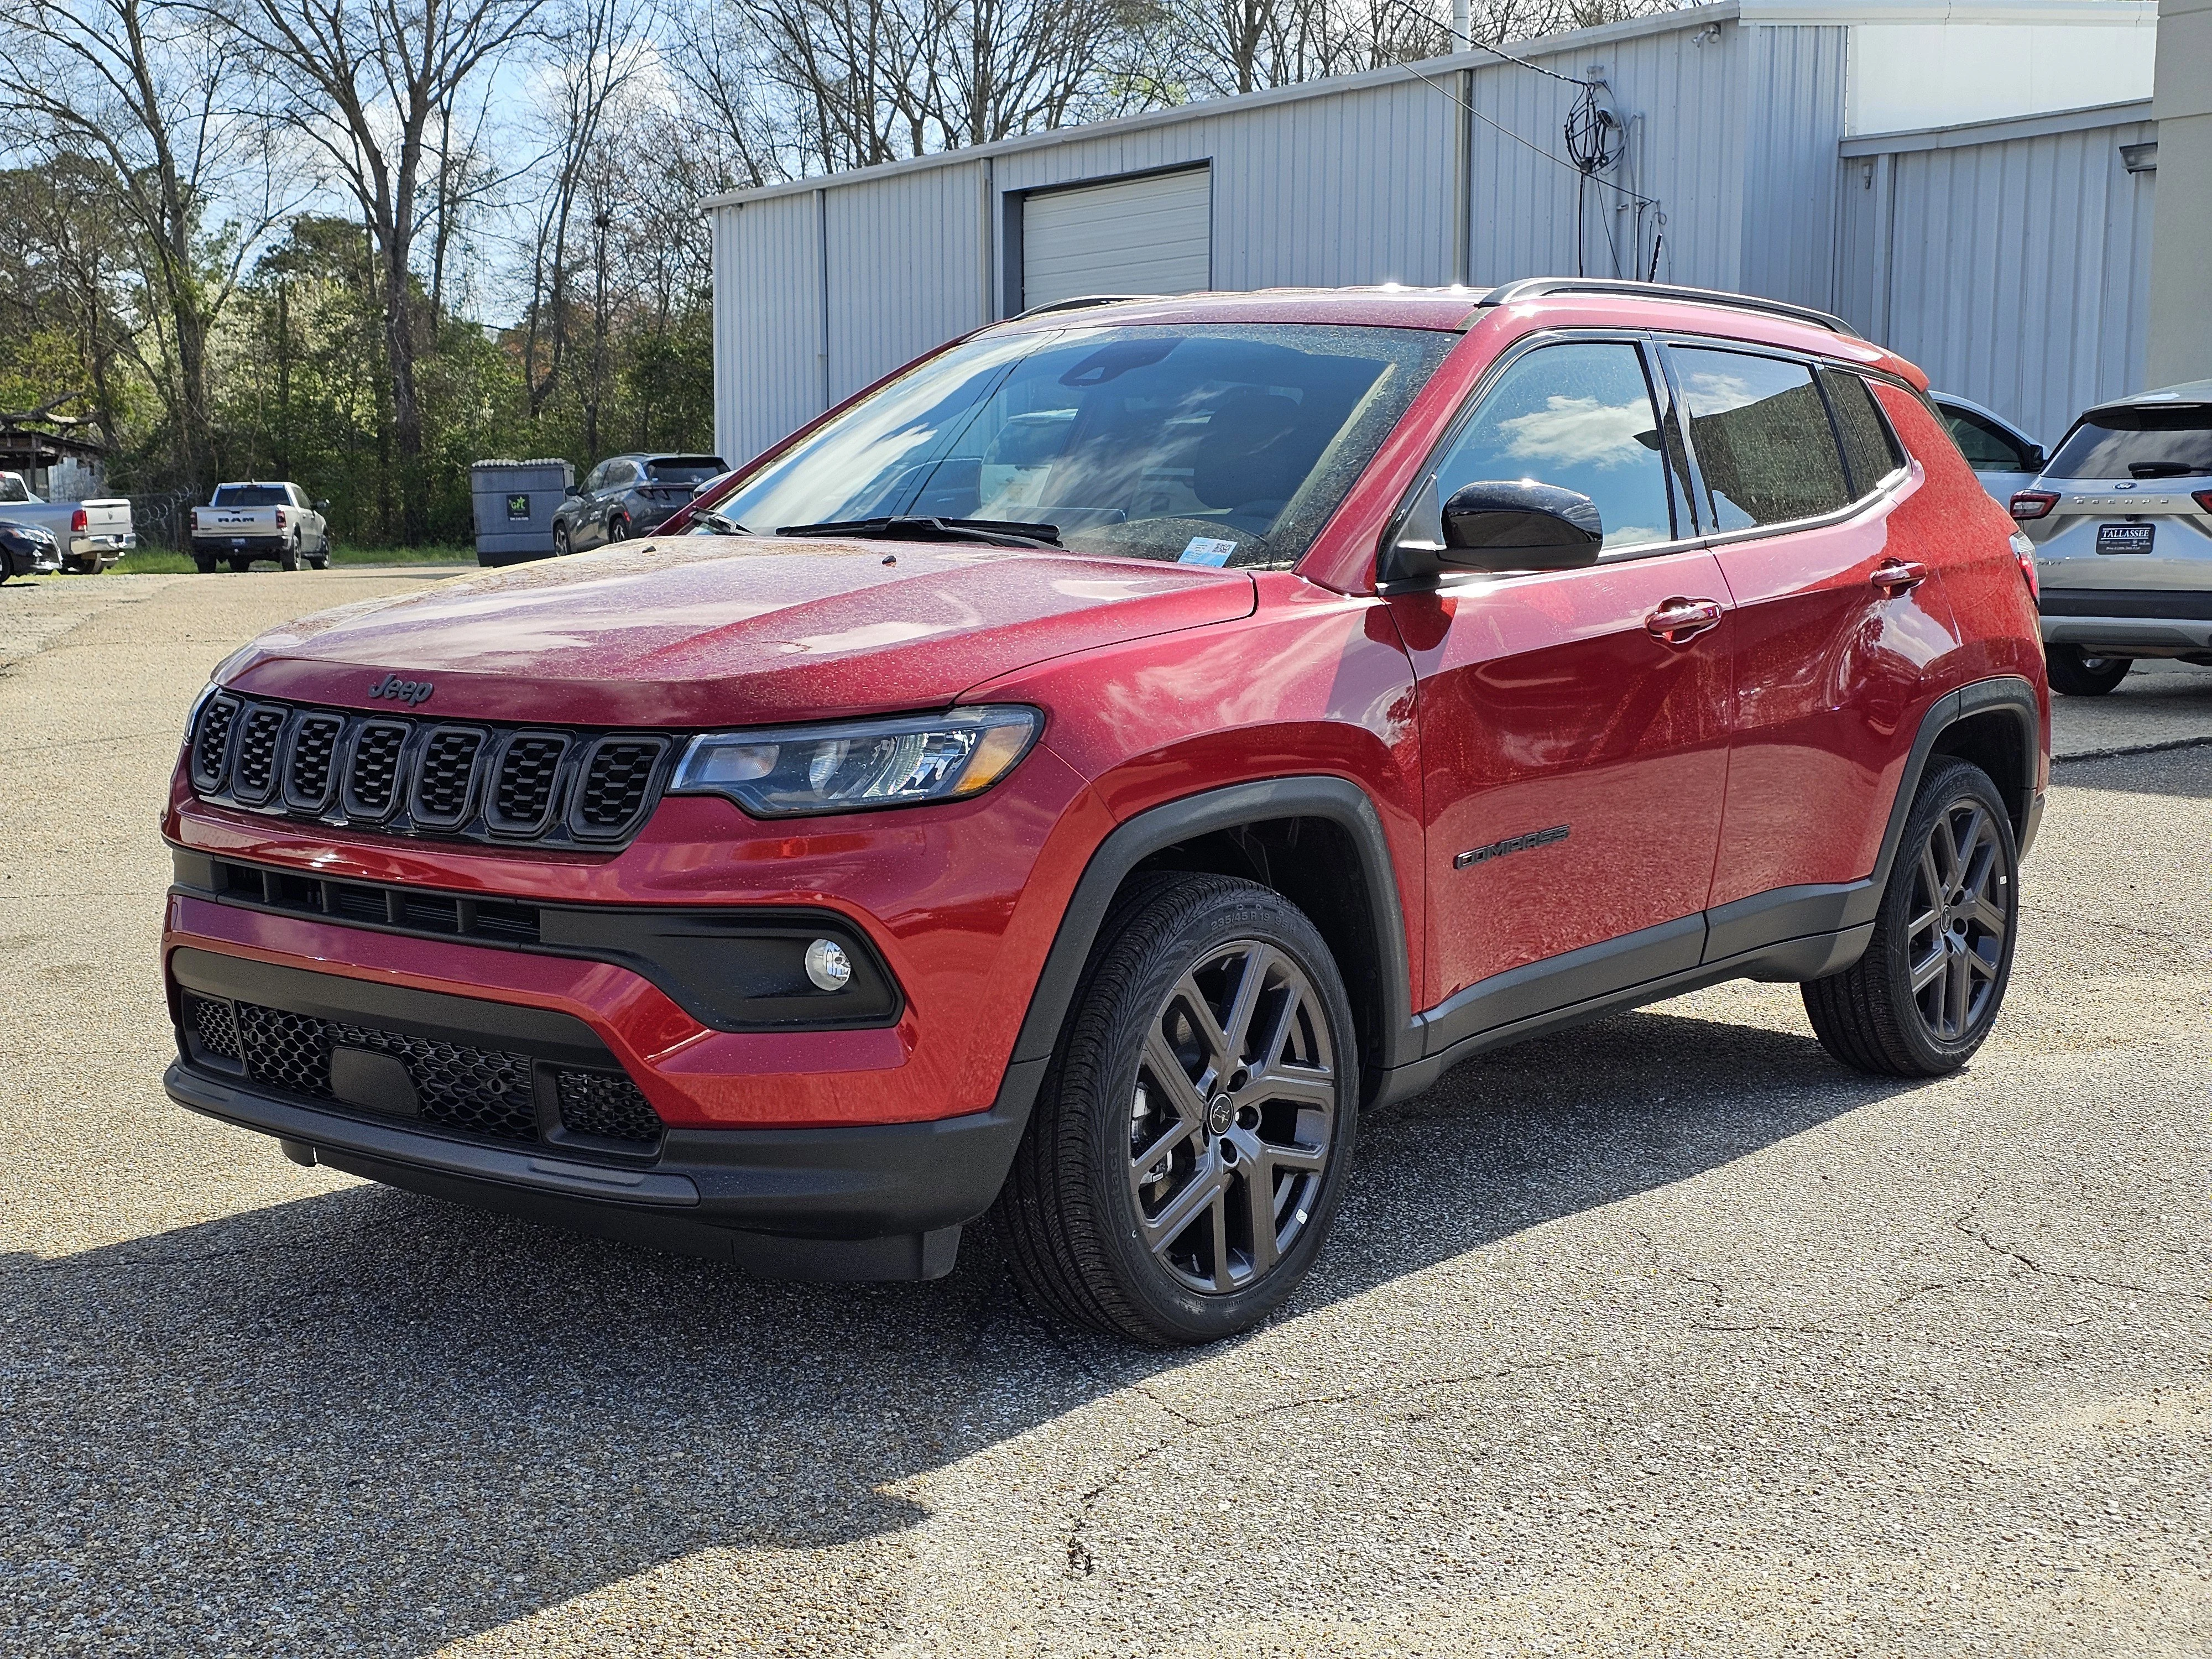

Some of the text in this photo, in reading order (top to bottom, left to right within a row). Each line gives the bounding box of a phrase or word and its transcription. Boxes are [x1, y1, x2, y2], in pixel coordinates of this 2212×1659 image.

[2103, 529, 2150, 538] TALLASSEE
[368, 673, 434, 707] Jeep
[1454, 825, 1571, 870] COMPASS
[1210, 912, 1249, 931] 235/45
